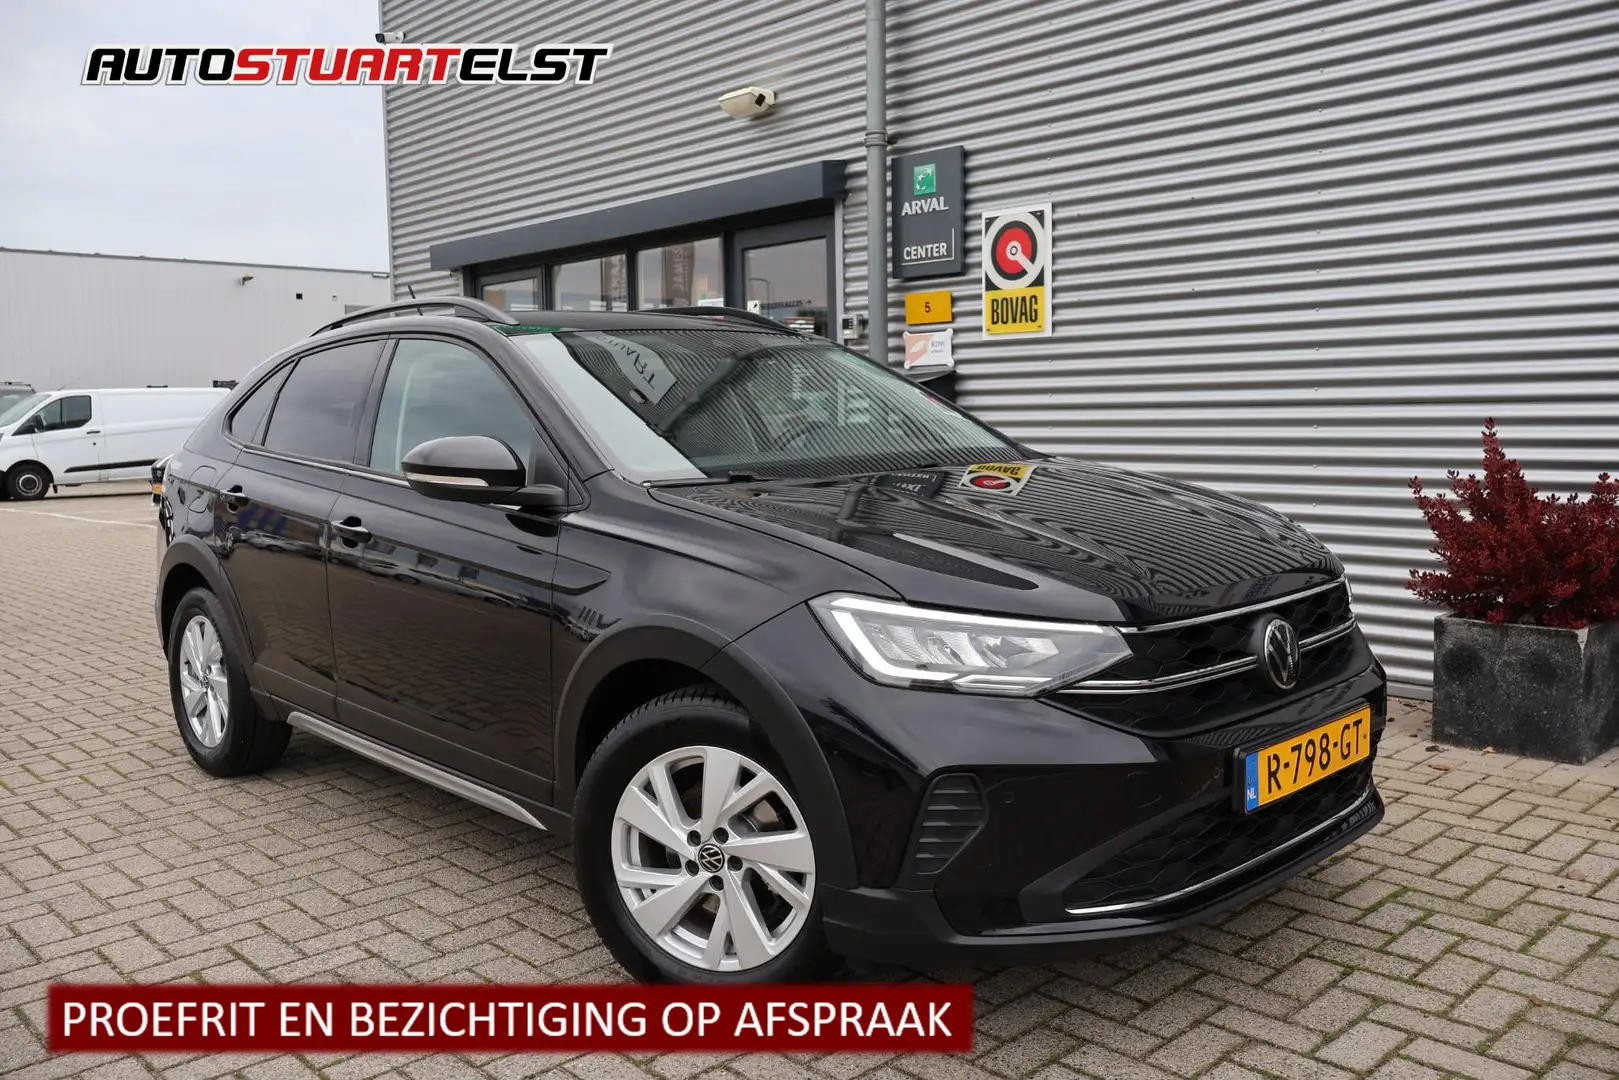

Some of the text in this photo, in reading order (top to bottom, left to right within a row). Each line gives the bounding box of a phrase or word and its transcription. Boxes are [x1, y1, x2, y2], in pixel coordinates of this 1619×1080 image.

[901, 197, 948, 216] ARVAL
[903, 243, 947, 260] CENTER
[924, 302, 931, 313] 5
[991, 295, 1038, 324] BOVAG
[1267, 718, 1363, 794] R-798-GT
[1247, 788, 1257, 800] NL
